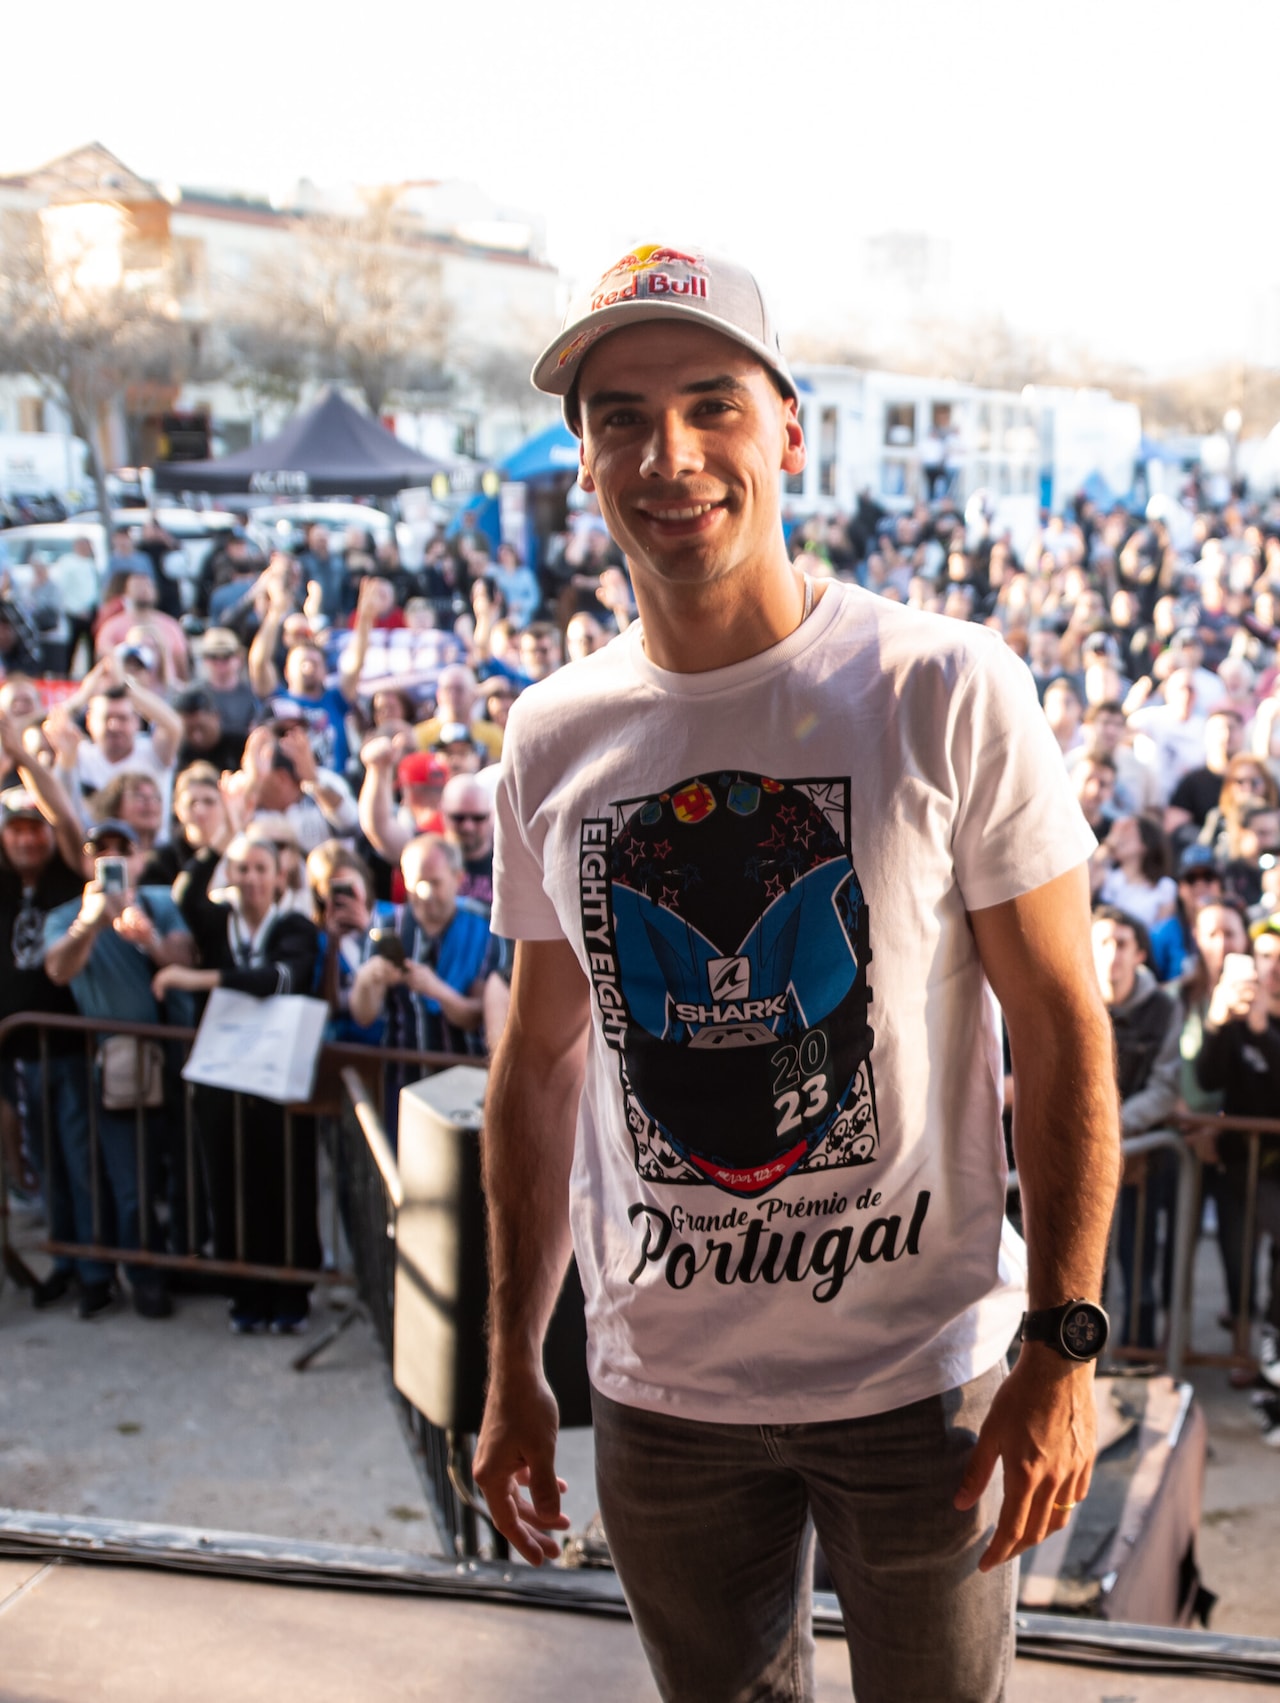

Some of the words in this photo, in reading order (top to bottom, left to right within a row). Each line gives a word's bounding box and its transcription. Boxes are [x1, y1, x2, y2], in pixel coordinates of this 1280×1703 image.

[590, 273, 639, 312] Red
[648, 273, 707, 298] Bull
[582, 823, 611, 947] EIGHTY
[590, 952, 629, 1049] EIGHT
[675, 994, 786, 1024] SHARK
[771, 1029, 827, 1095] 20
[773, 1073, 828, 1137] 23
[670, 1204, 750, 1233] Grande
[756, 1192, 847, 1222] Prémio
[856, 1188, 882, 1210] de
[627, 1190, 931, 1304] Portugal
